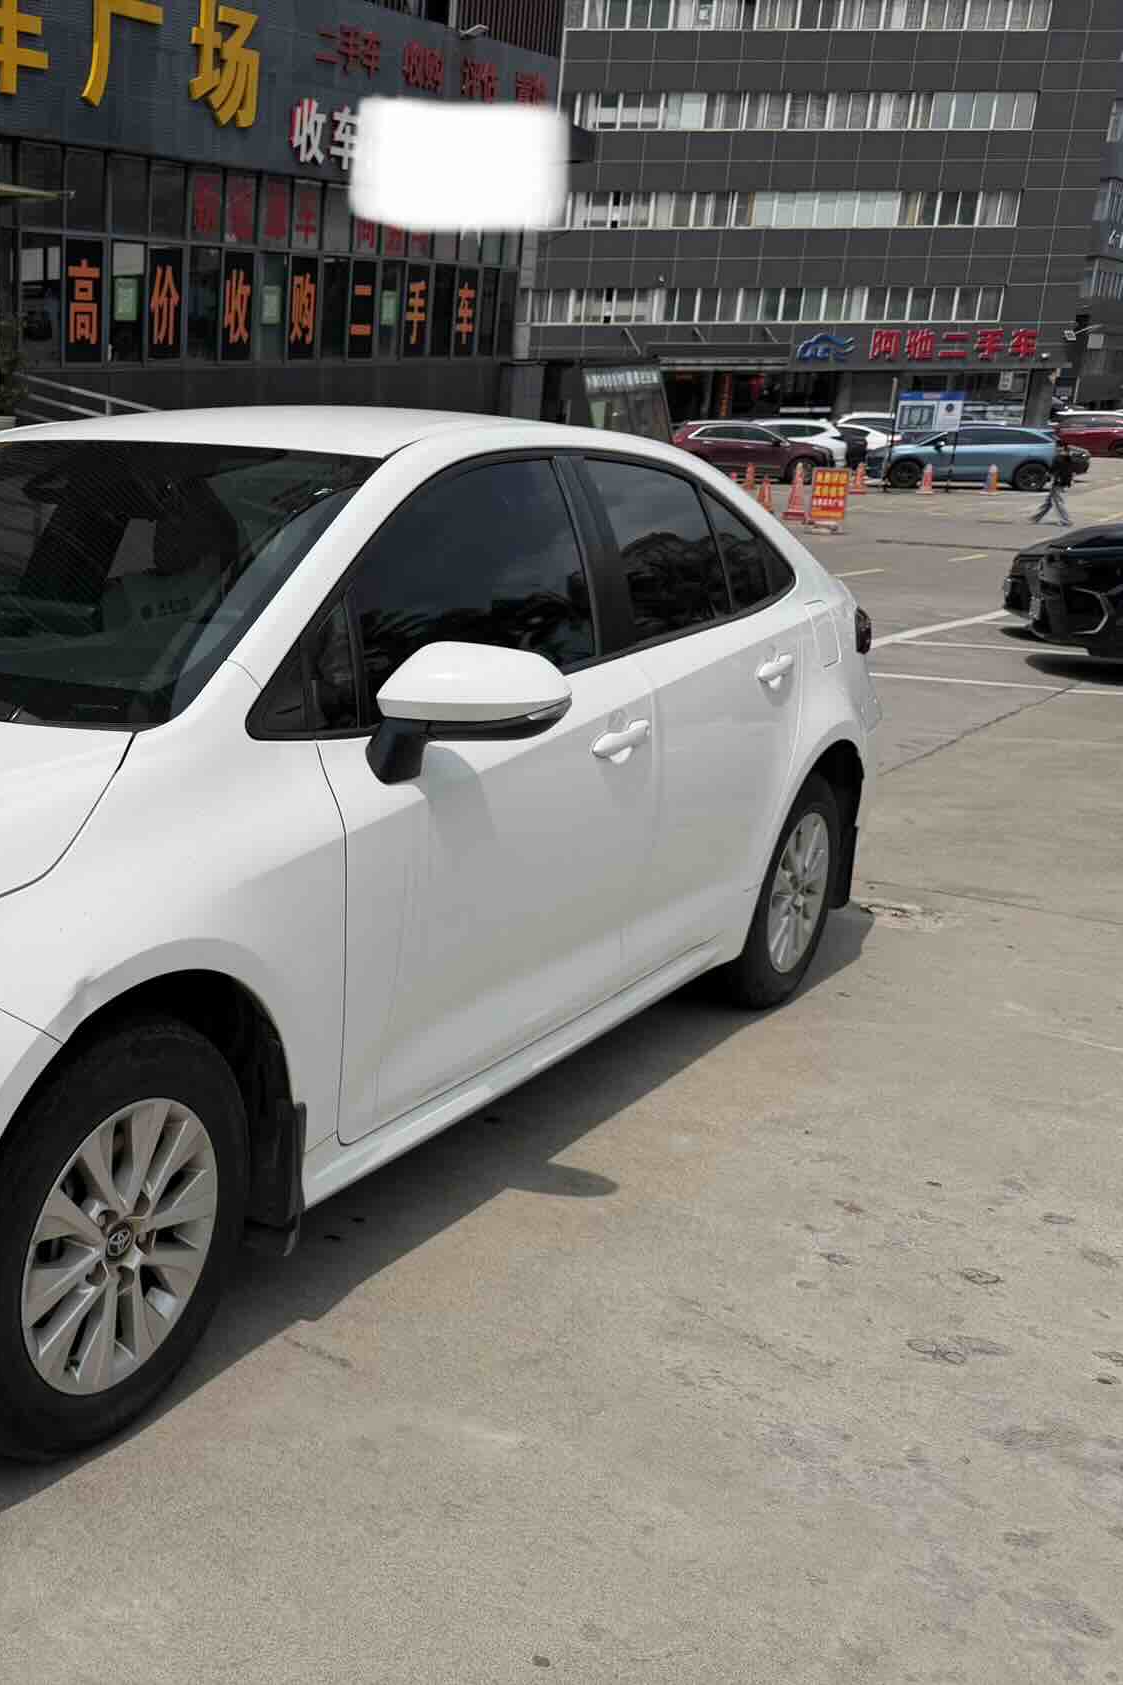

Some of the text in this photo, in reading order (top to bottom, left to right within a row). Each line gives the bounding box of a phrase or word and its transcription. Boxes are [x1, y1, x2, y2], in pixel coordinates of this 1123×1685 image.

[315, 25, 380, 78] 二手车
[402, 41, 444, 92] 收购
[68, 259, 476, 345] 高价收购二手车
